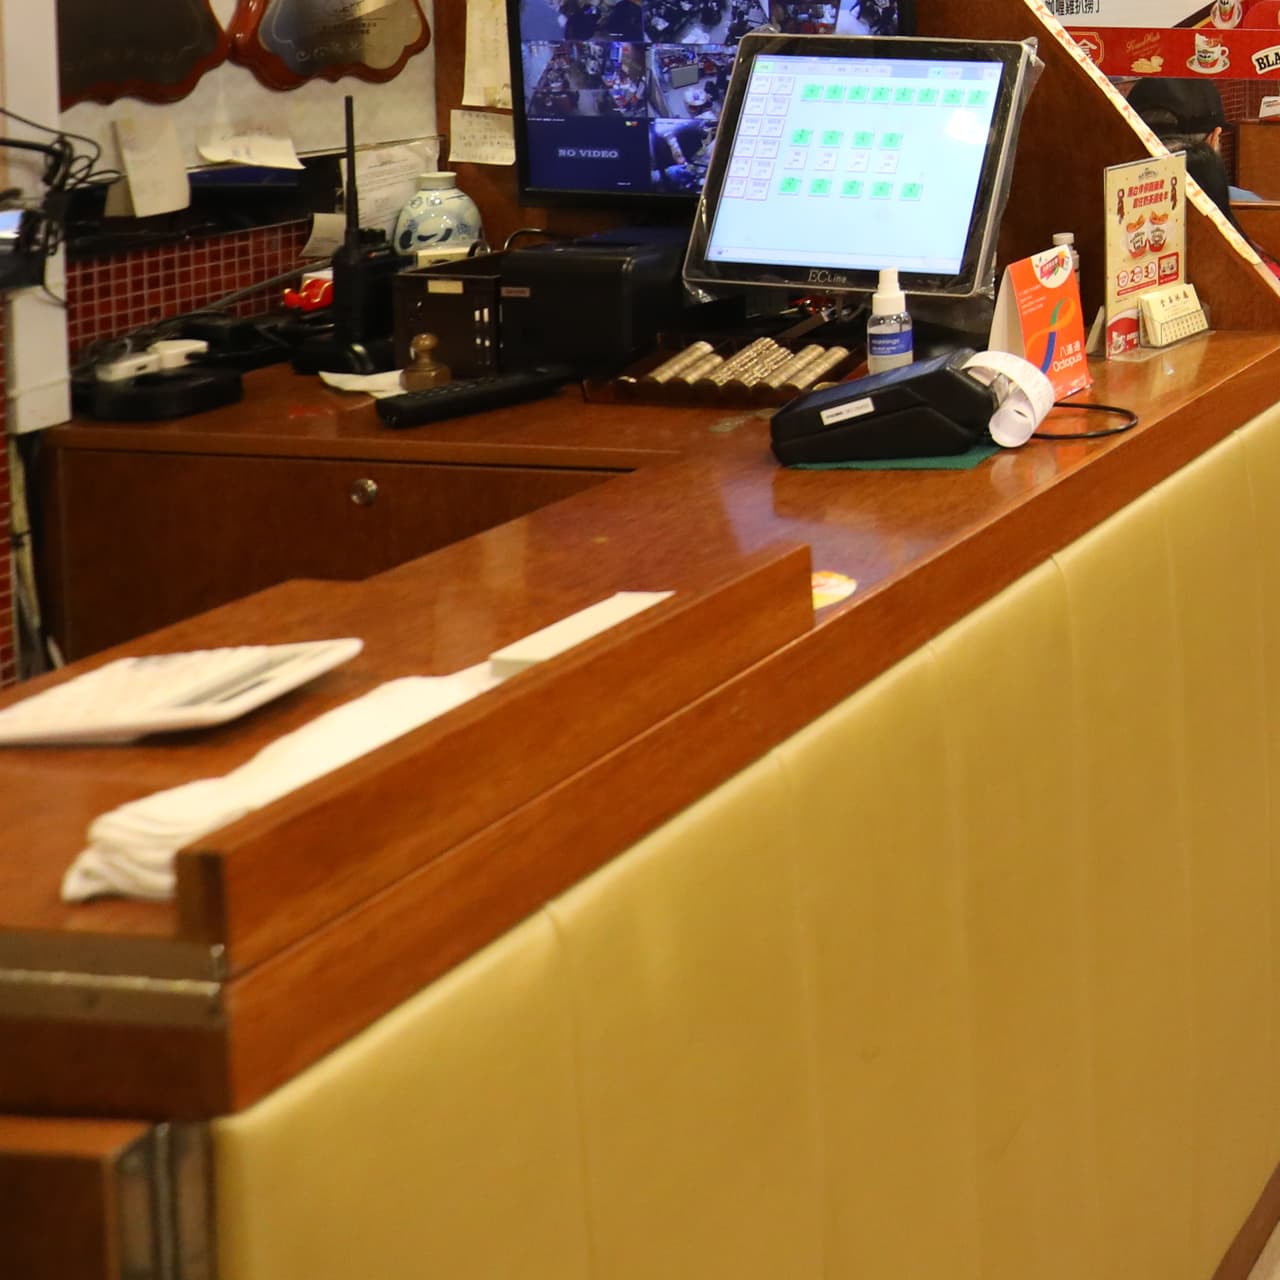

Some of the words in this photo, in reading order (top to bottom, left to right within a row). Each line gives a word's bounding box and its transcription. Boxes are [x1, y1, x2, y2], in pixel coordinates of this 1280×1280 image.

[558, 147, 578, 158] NO
[582, 147, 620, 158] VIDEO
[1052, 352, 1083, 373] Octopus
